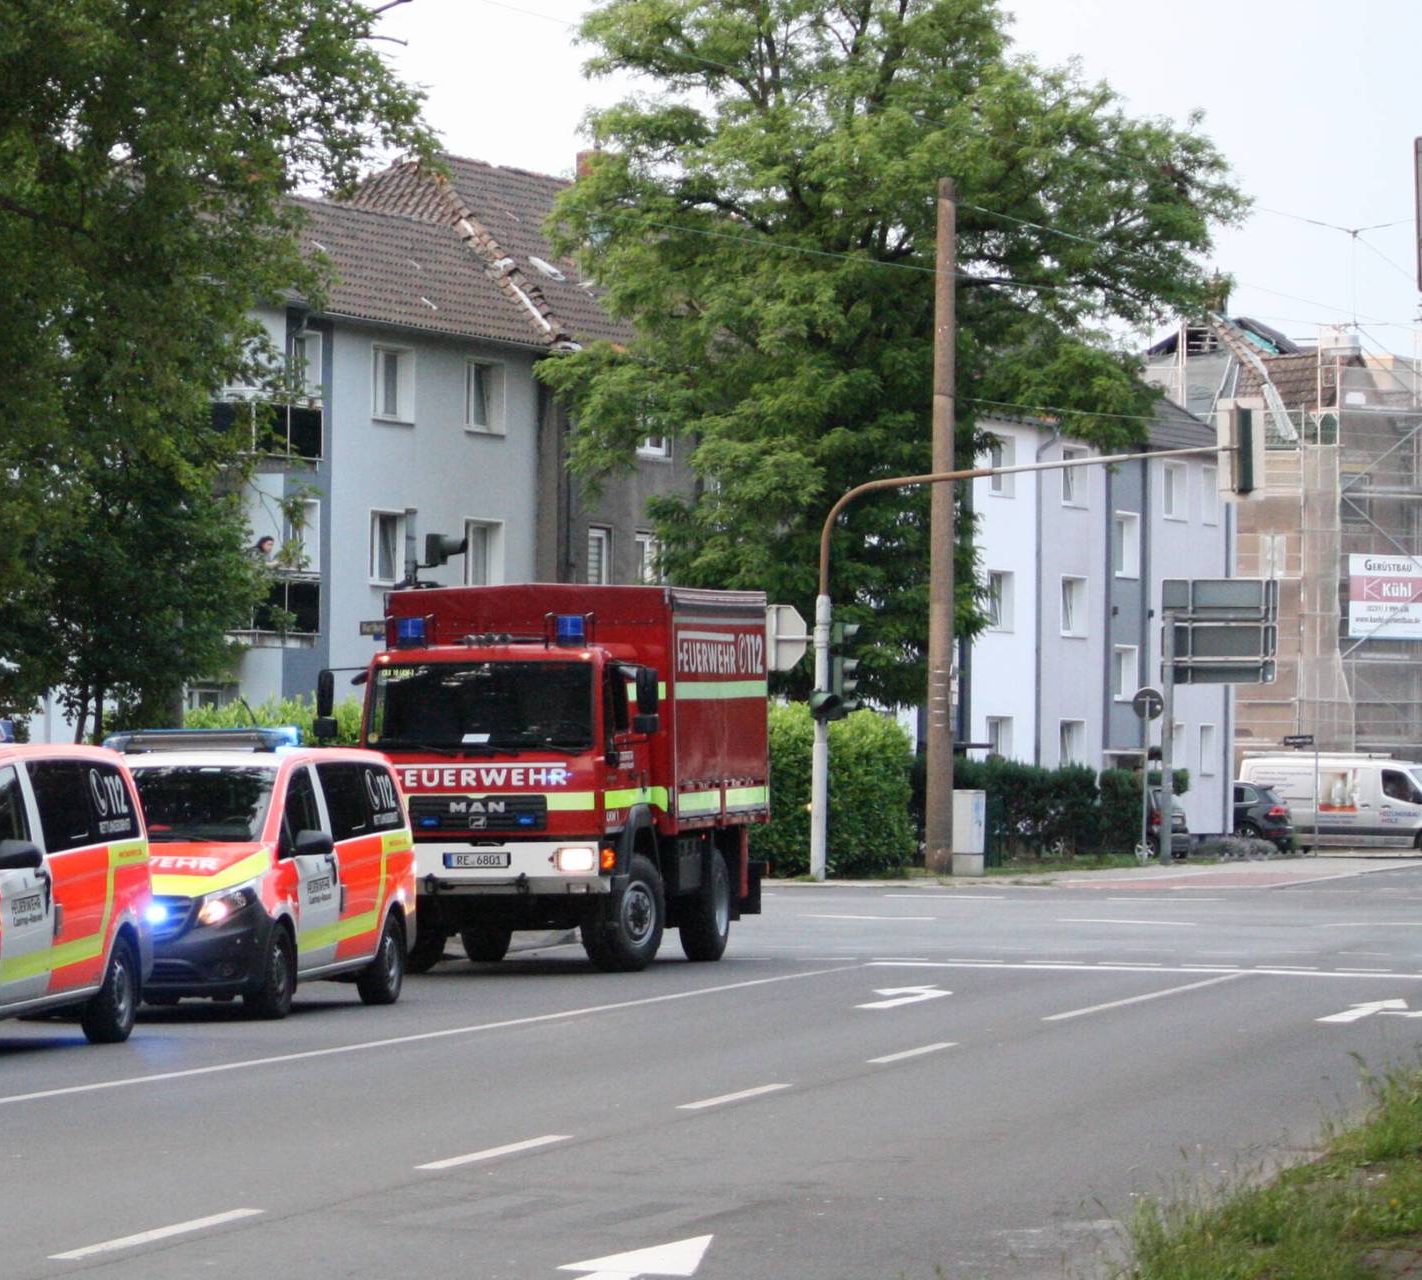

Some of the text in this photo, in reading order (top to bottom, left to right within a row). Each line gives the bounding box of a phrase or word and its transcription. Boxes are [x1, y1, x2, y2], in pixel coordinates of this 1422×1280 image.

[1382, 582, 1412, 597] Kühl
[677, 630, 763, 674] FEUERWEHR 112
[104, 774, 128, 814] 112
[376, 774, 396, 808] 112
[449, 801, 505, 813] MAN
[457, 855, 501, 865] RE 6801
